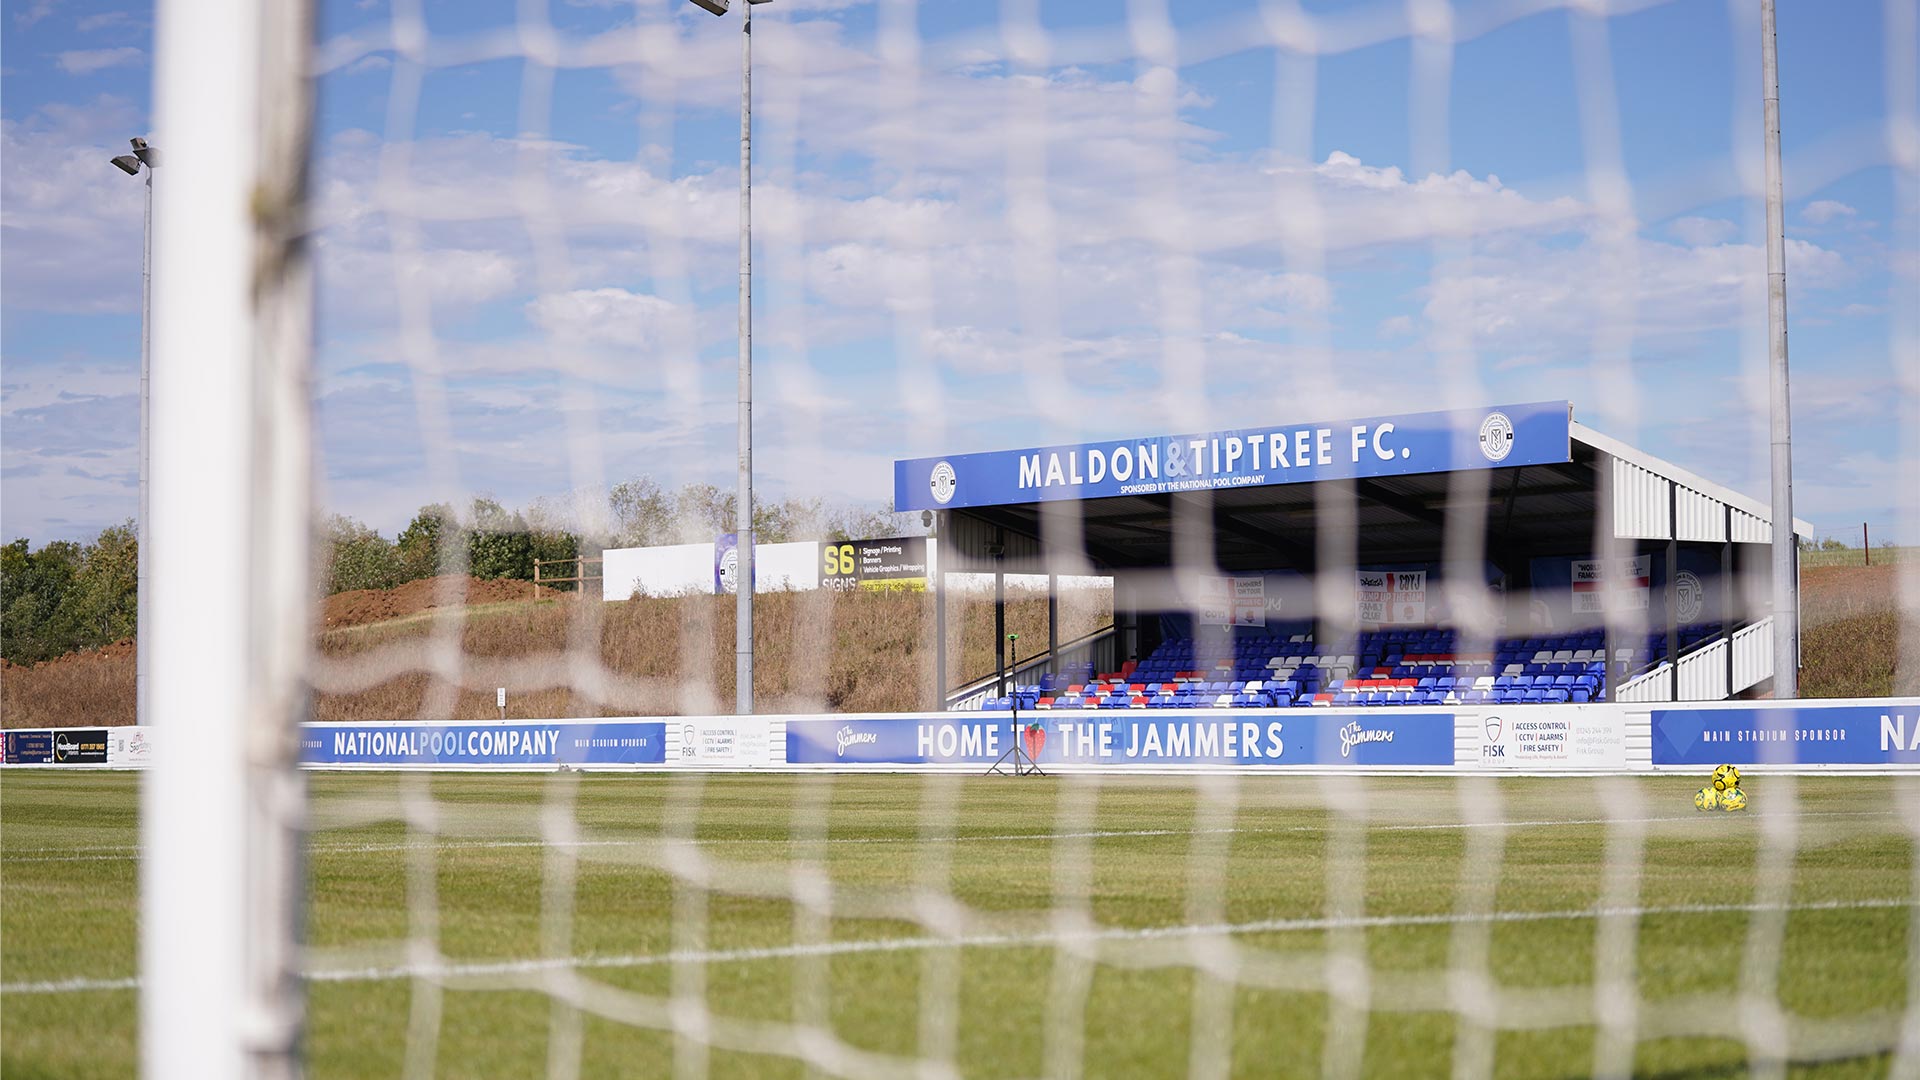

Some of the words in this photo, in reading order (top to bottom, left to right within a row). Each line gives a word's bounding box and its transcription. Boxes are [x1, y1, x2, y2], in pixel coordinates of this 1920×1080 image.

[1351, 423, 1411, 463] FC.
[1120, 483, 1157, 494] SPONSORED
[1158, 482, 1167, 492] BY
[1167, 481, 1179, 491] THE
[1180, 479, 1212, 490] NATIONAL
[1213, 477, 1231, 487] POOL
[1232, 475, 1265, 486] COMPANY
[863, 547, 880, 556] Signage
[883, 546, 902, 555] Printing
[824, 544, 855, 576] S6
[879, 565, 899, 573] Graphics
[903, 564, 925, 573] Wrapping
[842, 725, 853, 735] The
[1347, 721, 1362, 733] The
[1515, 722, 1538, 731] ACCESS
[1539, 722, 1567, 730] CONTROL
[917, 724, 998, 757] HOME
[1058, 723, 1113, 758] THE
[1126, 722, 1284, 759] JAMMERS
[1518, 733, 1534, 741] CCTV
[1539, 733, 1564, 741] ALARMS
[1703, 730, 1730, 742] MAIN
[1738, 730, 1787, 742] STADIUM
[1795, 729, 1846, 741] SPONSOR
[837, 729, 877, 756] Jammers
[1340, 727, 1394, 758] Jammers
[1523, 744, 1536, 752] FIRE
[1537, 744, 1559, 752] SAFETY
[682, 747, 696, 757] FISK
[1483, 745, 1505, 757] FISK
